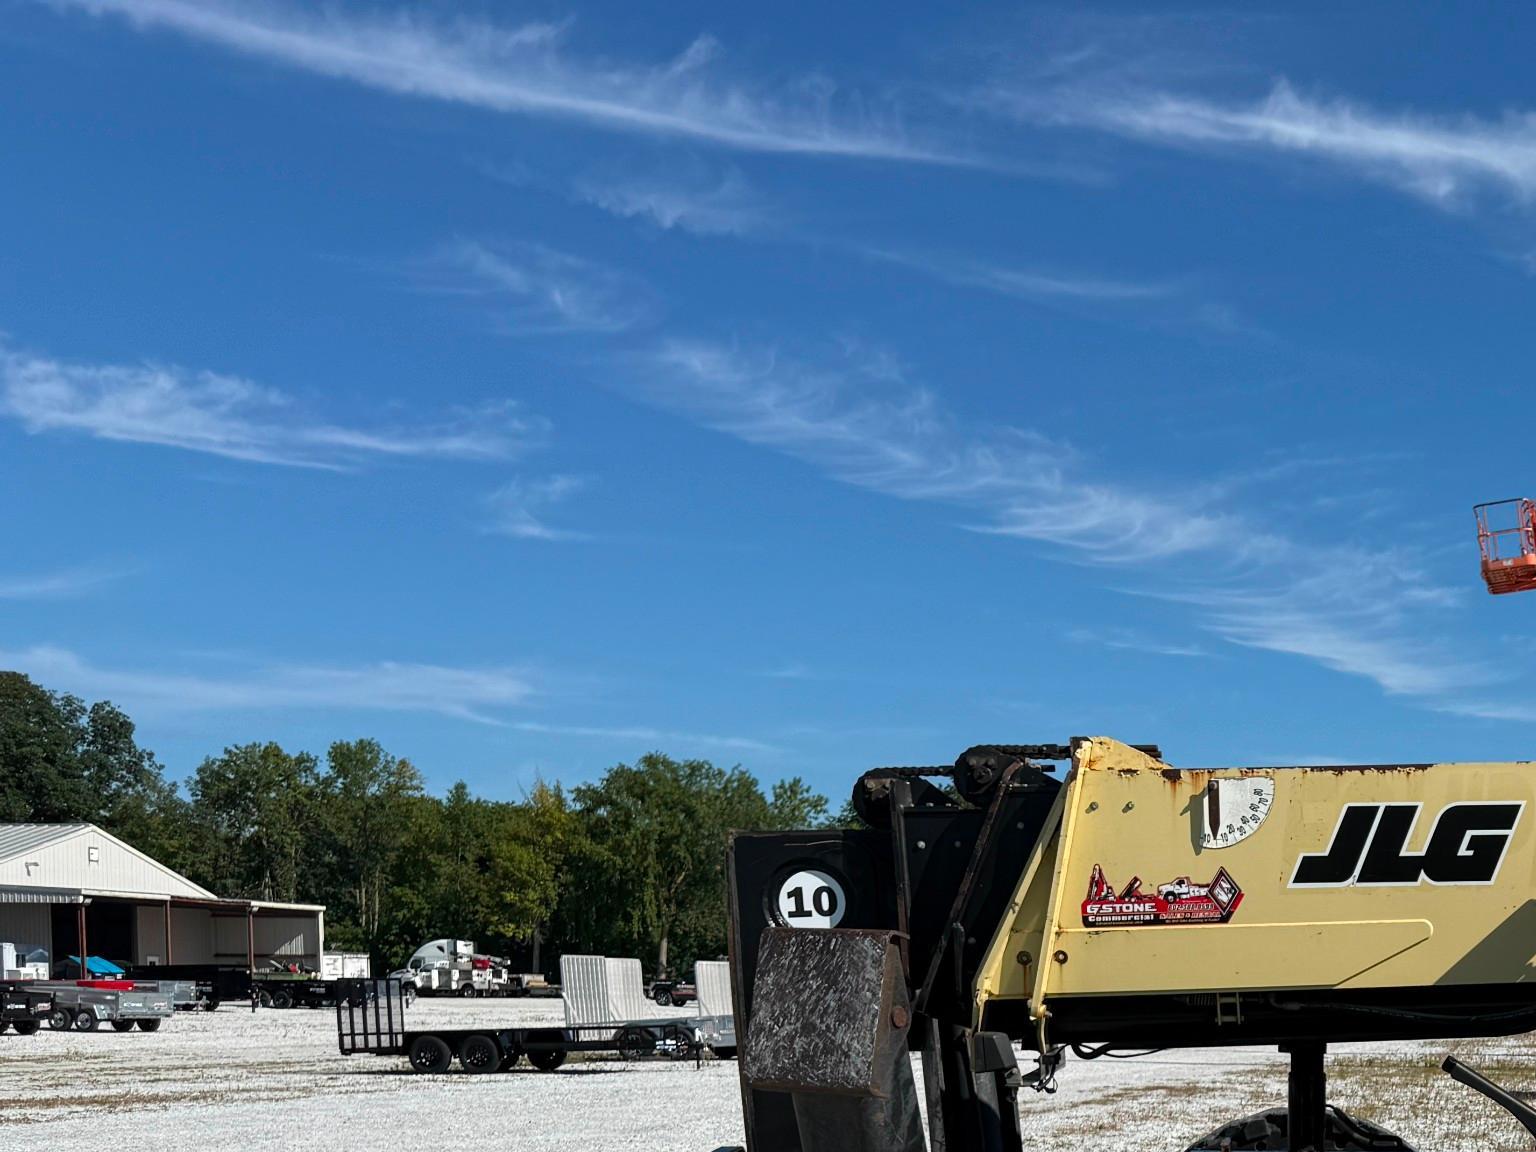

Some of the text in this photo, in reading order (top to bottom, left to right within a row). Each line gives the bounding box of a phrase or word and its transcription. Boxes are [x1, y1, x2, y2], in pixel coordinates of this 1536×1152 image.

[1258, 797, 1268, 806] 70
[1249, 803, 1260, 812] 60
[1240, 815, 1250, 825] 40
[1249, 813, 1260, 824] 50
[1226, 823, 1236, 834] 20
[1237, 825, 1247, 836] 30
[1220, 832, 1229, 843] 10
[1288, 801, 1526, 888] JLG
[786, 886, 838, 918] 10
[1088, 914, 1154, 922] Commercial
